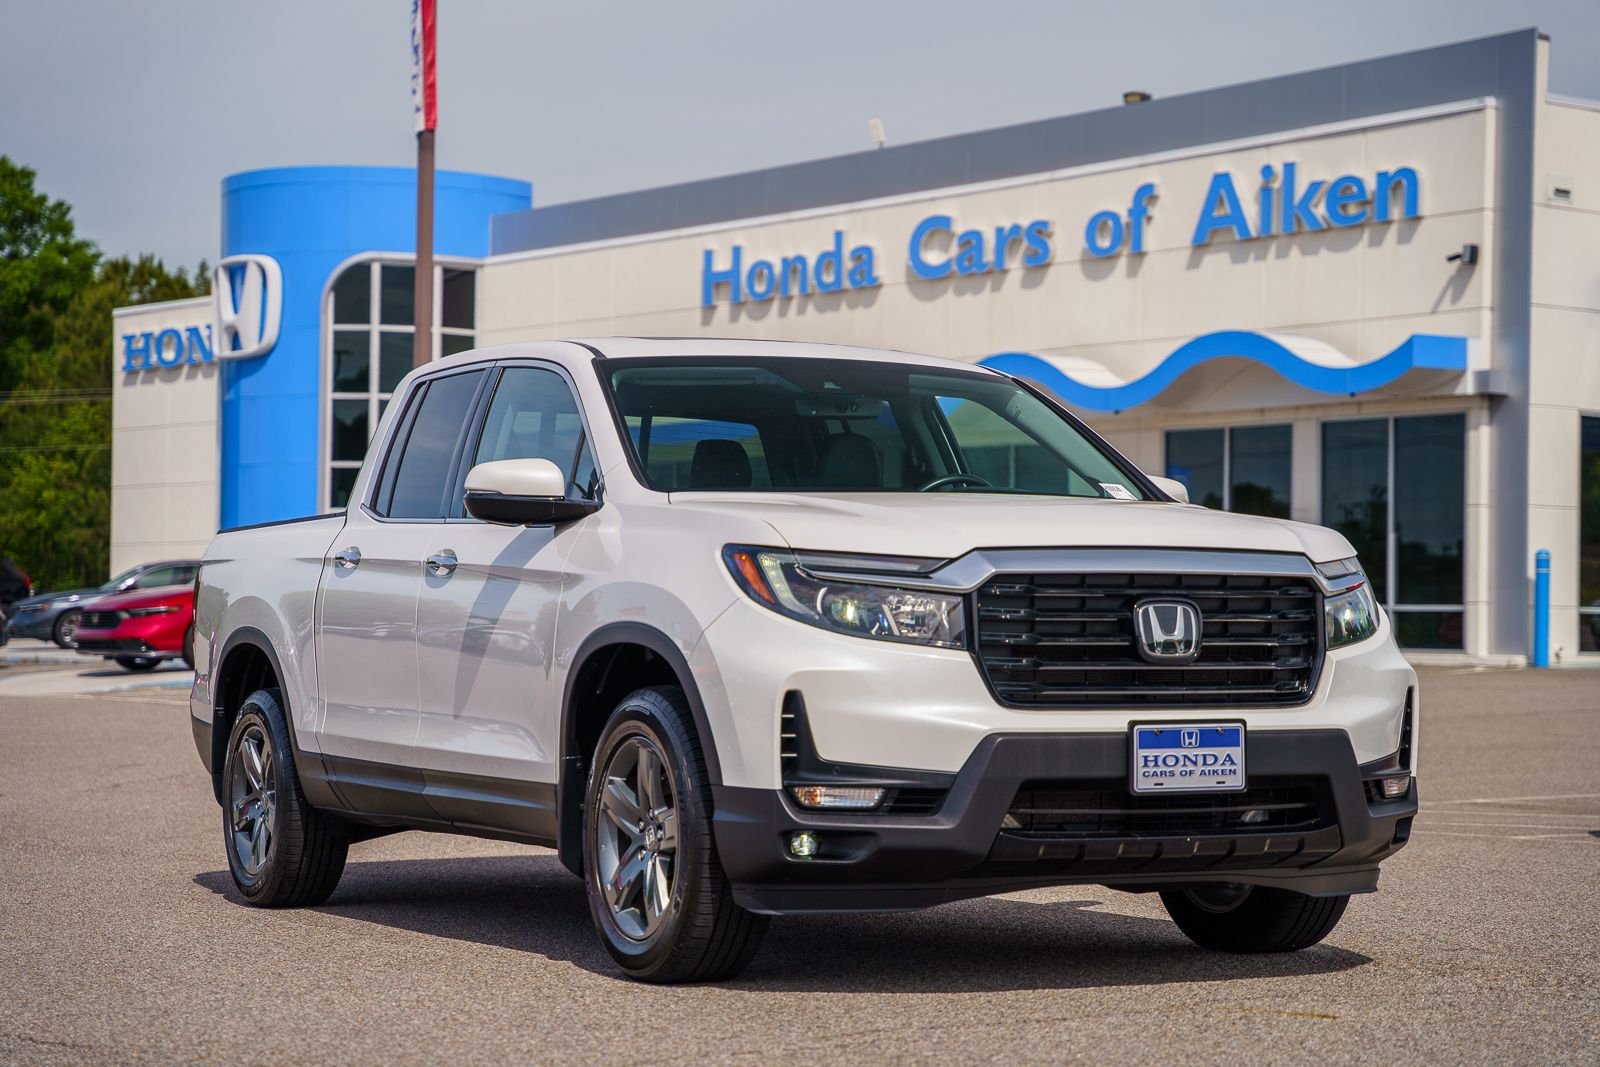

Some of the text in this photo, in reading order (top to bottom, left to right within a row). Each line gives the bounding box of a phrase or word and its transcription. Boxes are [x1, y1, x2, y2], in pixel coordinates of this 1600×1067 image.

[702, 160, 1421, 307] Honda Cars of Aiken
[1141, 752, 1238, 768] HONDA
[1142, 768, 1237, 778] CARS OF AIKEN
